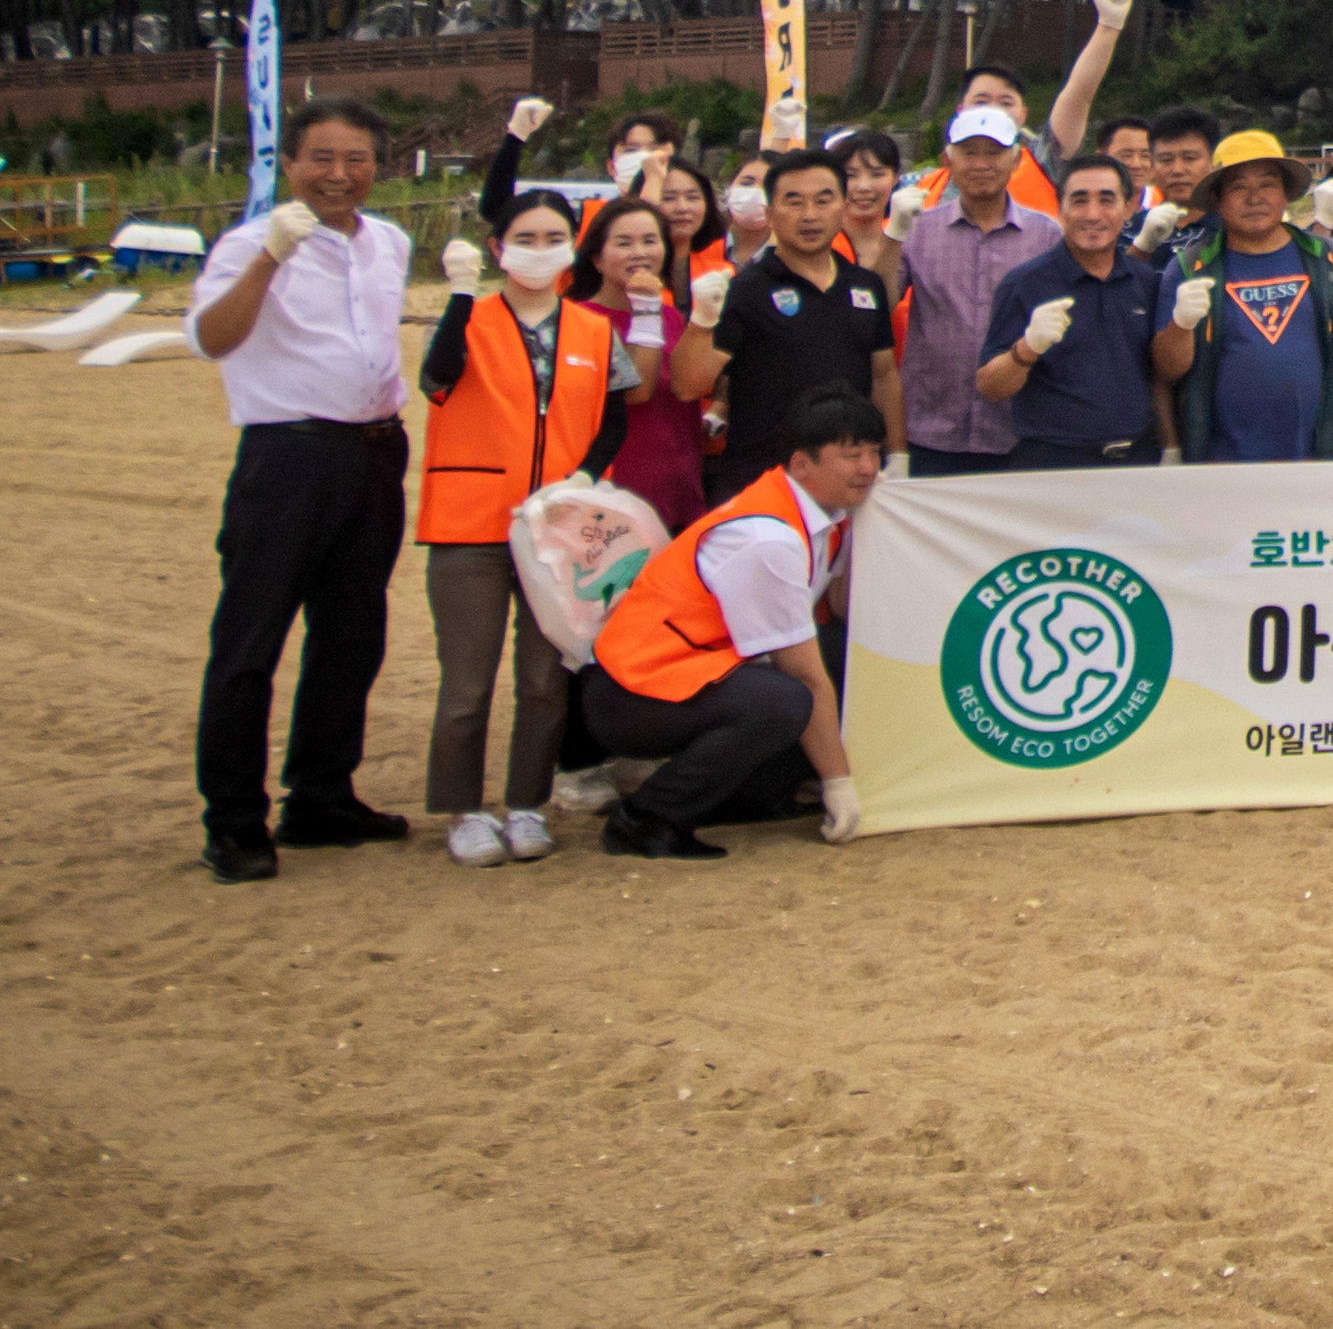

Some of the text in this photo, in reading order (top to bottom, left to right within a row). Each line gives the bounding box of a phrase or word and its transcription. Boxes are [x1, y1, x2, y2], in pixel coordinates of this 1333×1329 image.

[1240, 283, 1298, 302] GUESS
[976, 555, 1144, 610] RECOTHER
[956, 678, 1154, 759] RESOM ECO TOGETHER
